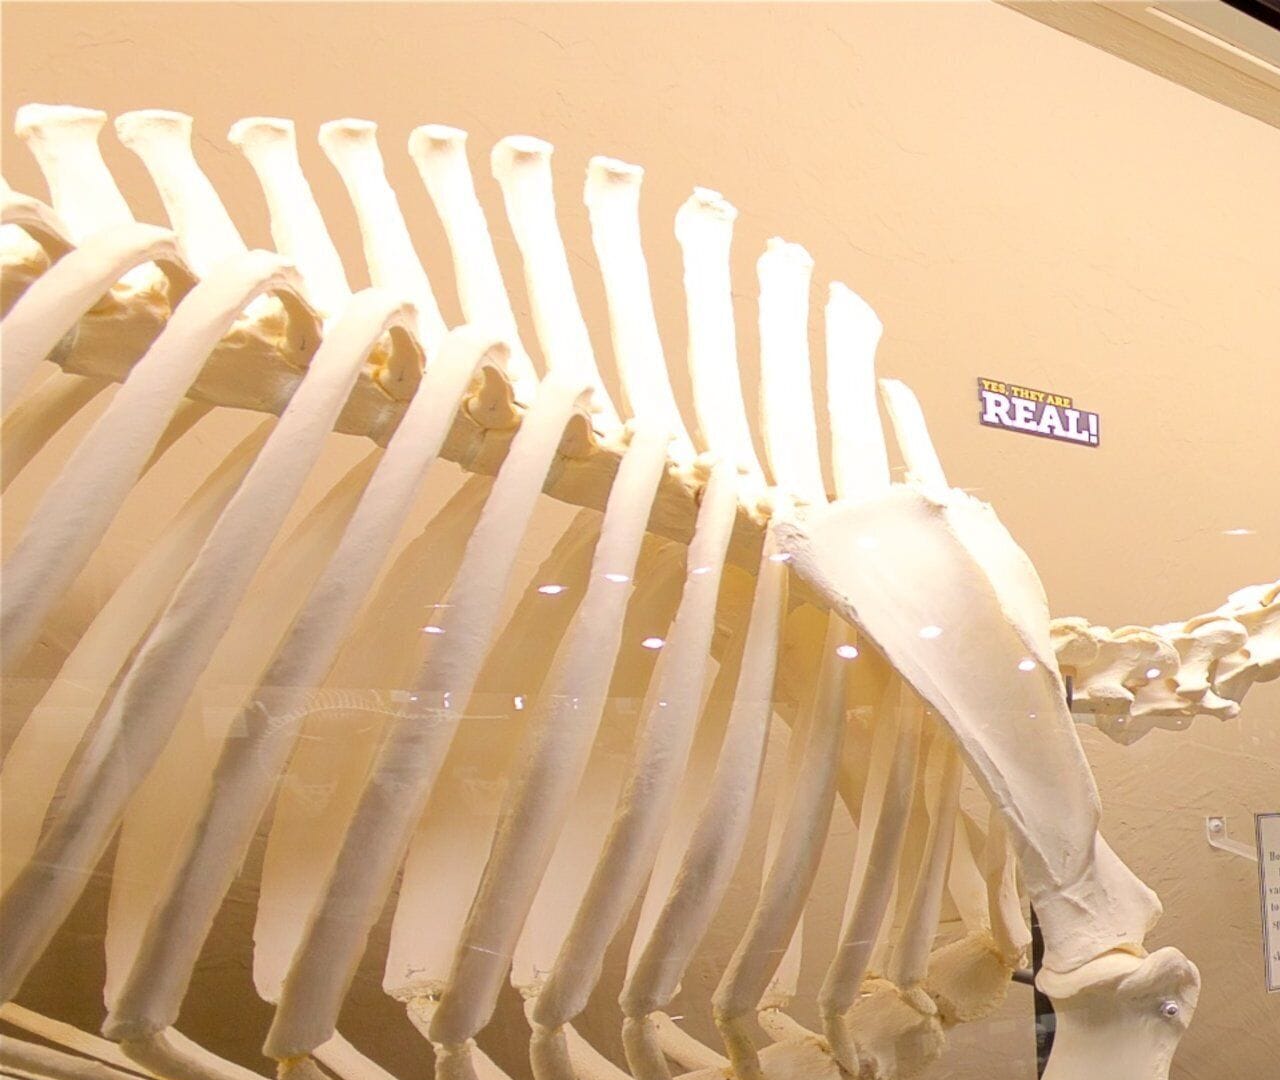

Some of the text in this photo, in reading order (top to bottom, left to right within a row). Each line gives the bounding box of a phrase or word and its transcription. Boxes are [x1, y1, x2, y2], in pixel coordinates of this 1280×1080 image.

[983, 380, 1071, 408] YES, THEY ARE
[982, 390, 1098, 444] REAL!
